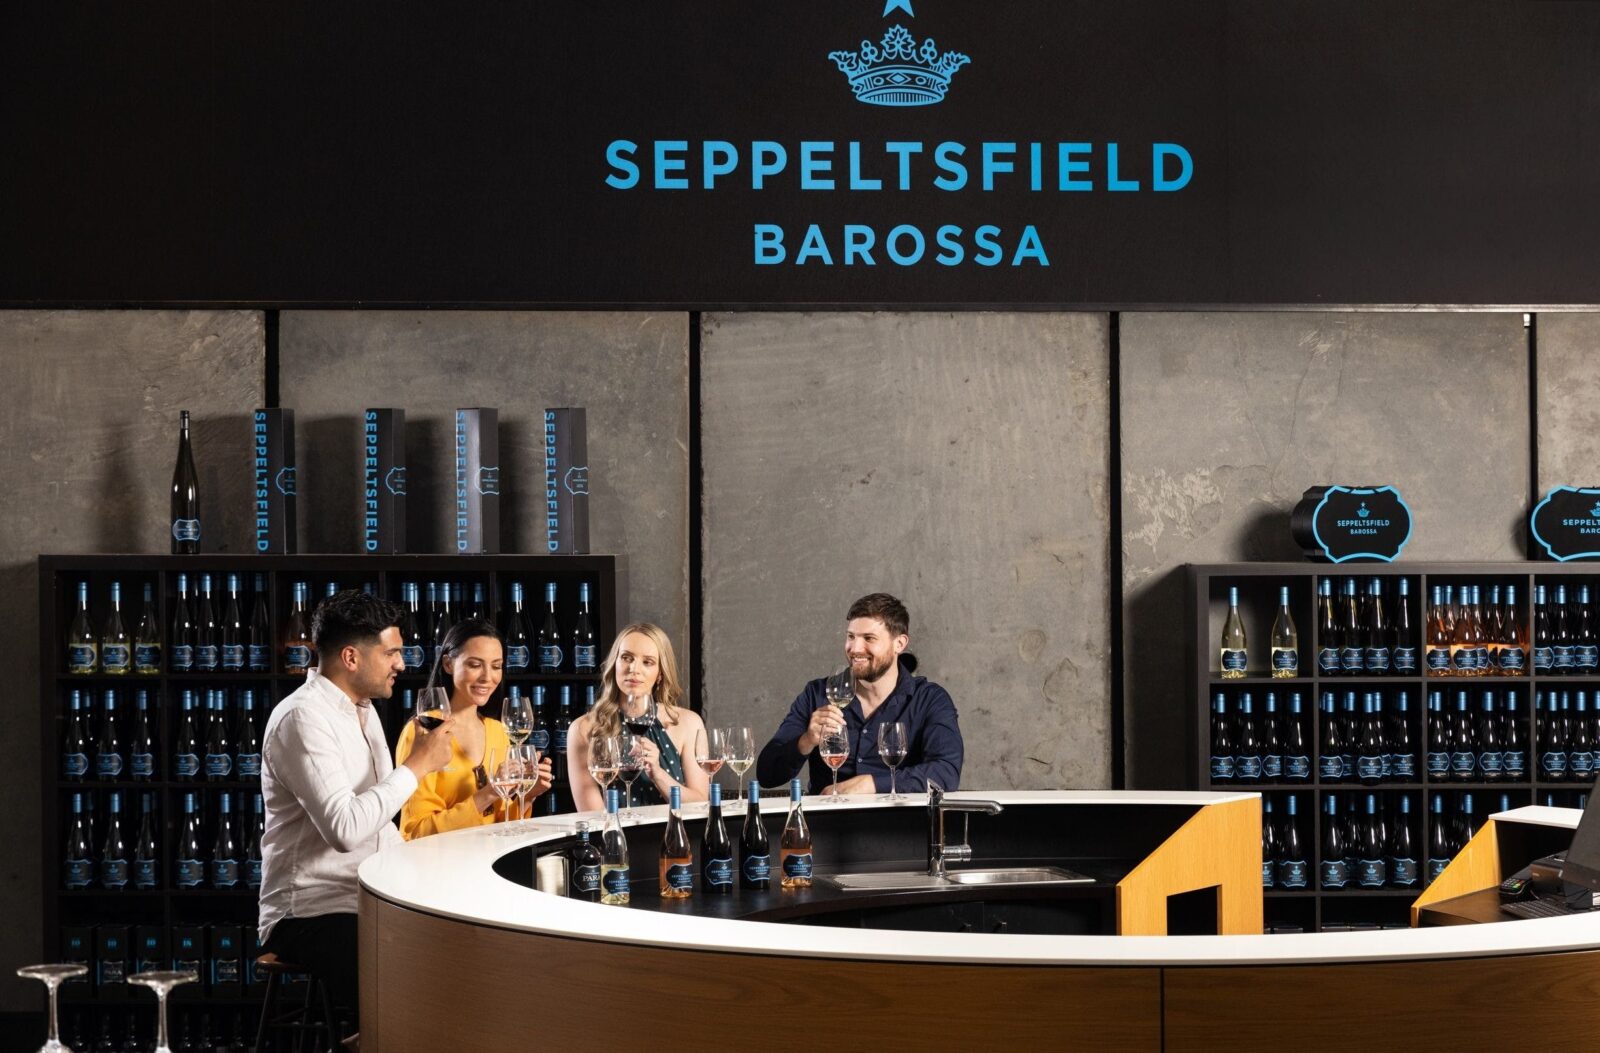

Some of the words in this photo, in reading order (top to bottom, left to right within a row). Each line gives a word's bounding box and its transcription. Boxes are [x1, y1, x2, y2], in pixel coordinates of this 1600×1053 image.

[605, 139, 1194, 192] SEPPELTSFIELD
[754, 223, 1050, 267] BAROSSA
[255, 412, 269, 551] SEPPELTSFIELD
[365, 411, 378, 551] SEPPELTSFIELD
[457, 411, 468, 551] SEPPELTSFIELD
[544, 411, 558, 551] SEPPELTSFIELD
[1337, 519, 1390, 527] SEPPELTSFIELD
